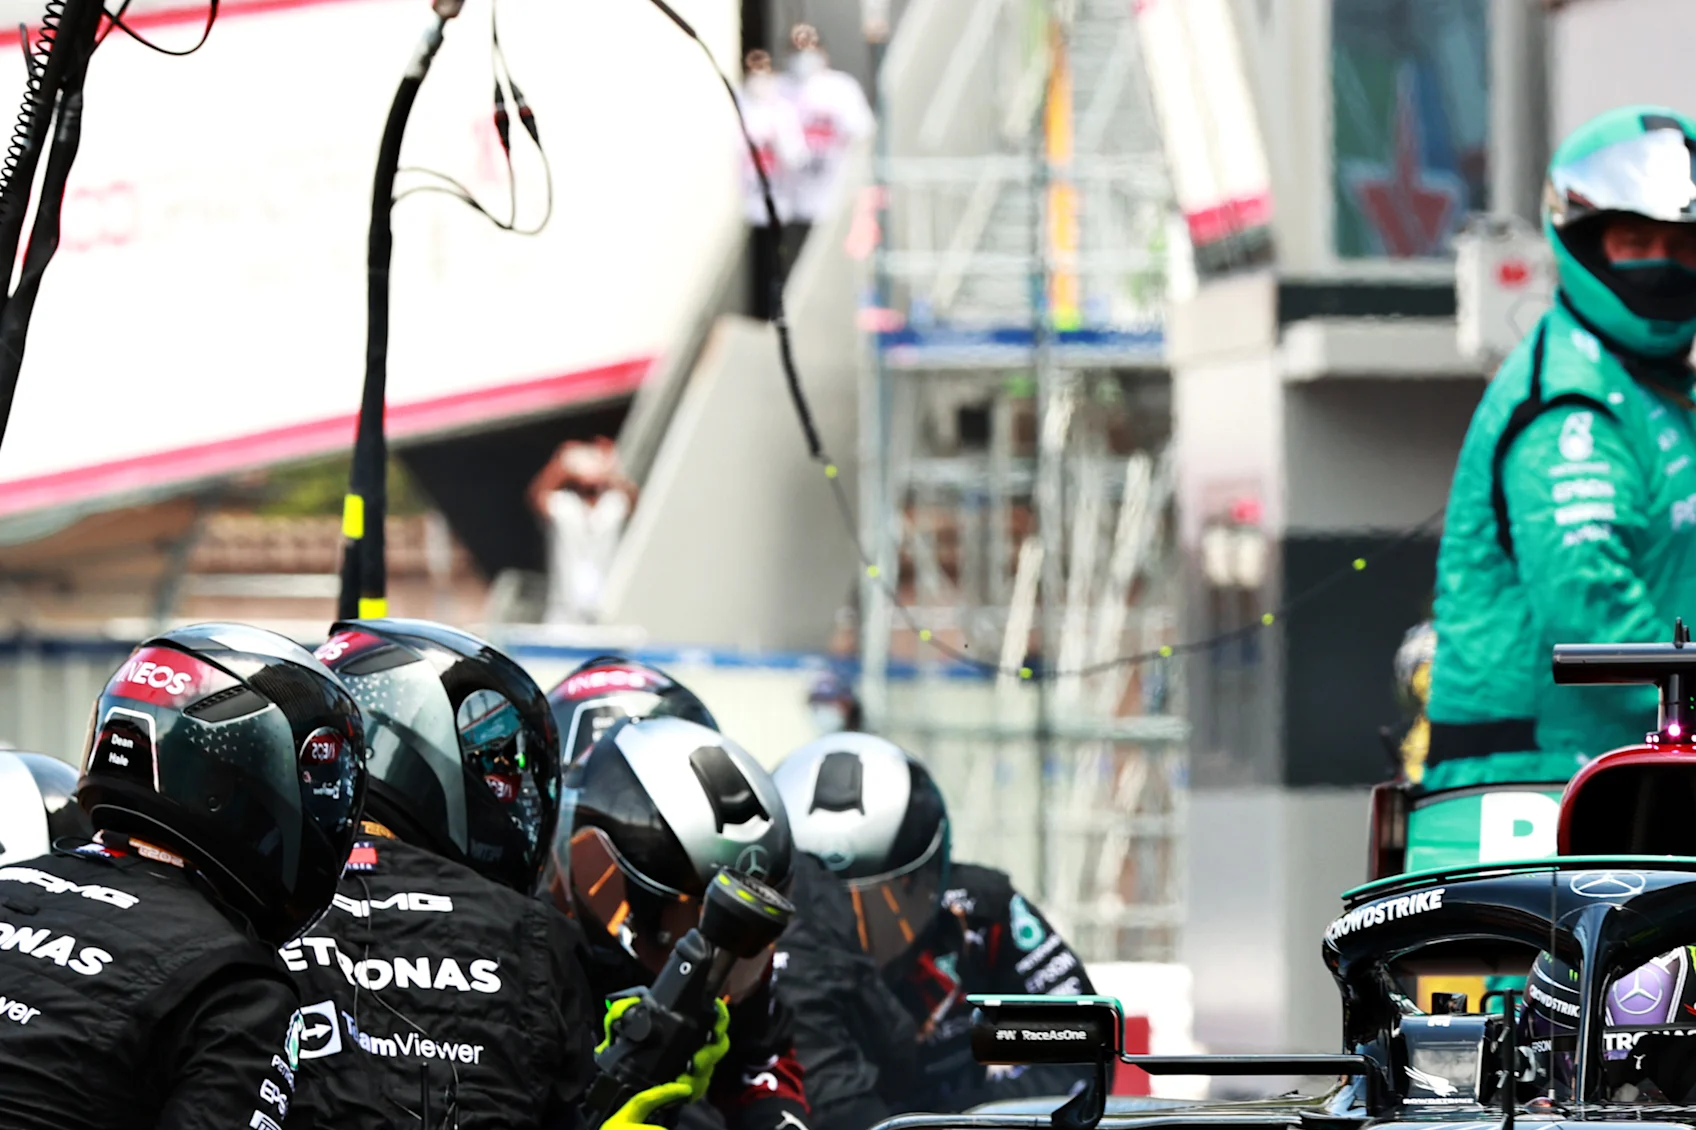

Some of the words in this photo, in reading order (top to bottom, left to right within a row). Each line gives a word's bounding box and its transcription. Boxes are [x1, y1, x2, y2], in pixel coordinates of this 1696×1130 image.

[116, 661, 191, 696] INEOS
[110, 733, 134, 749] Dean
[108, 752, 129, 767] Hale
[1328, 889, 1446, 941] CROWDSTRIKE
